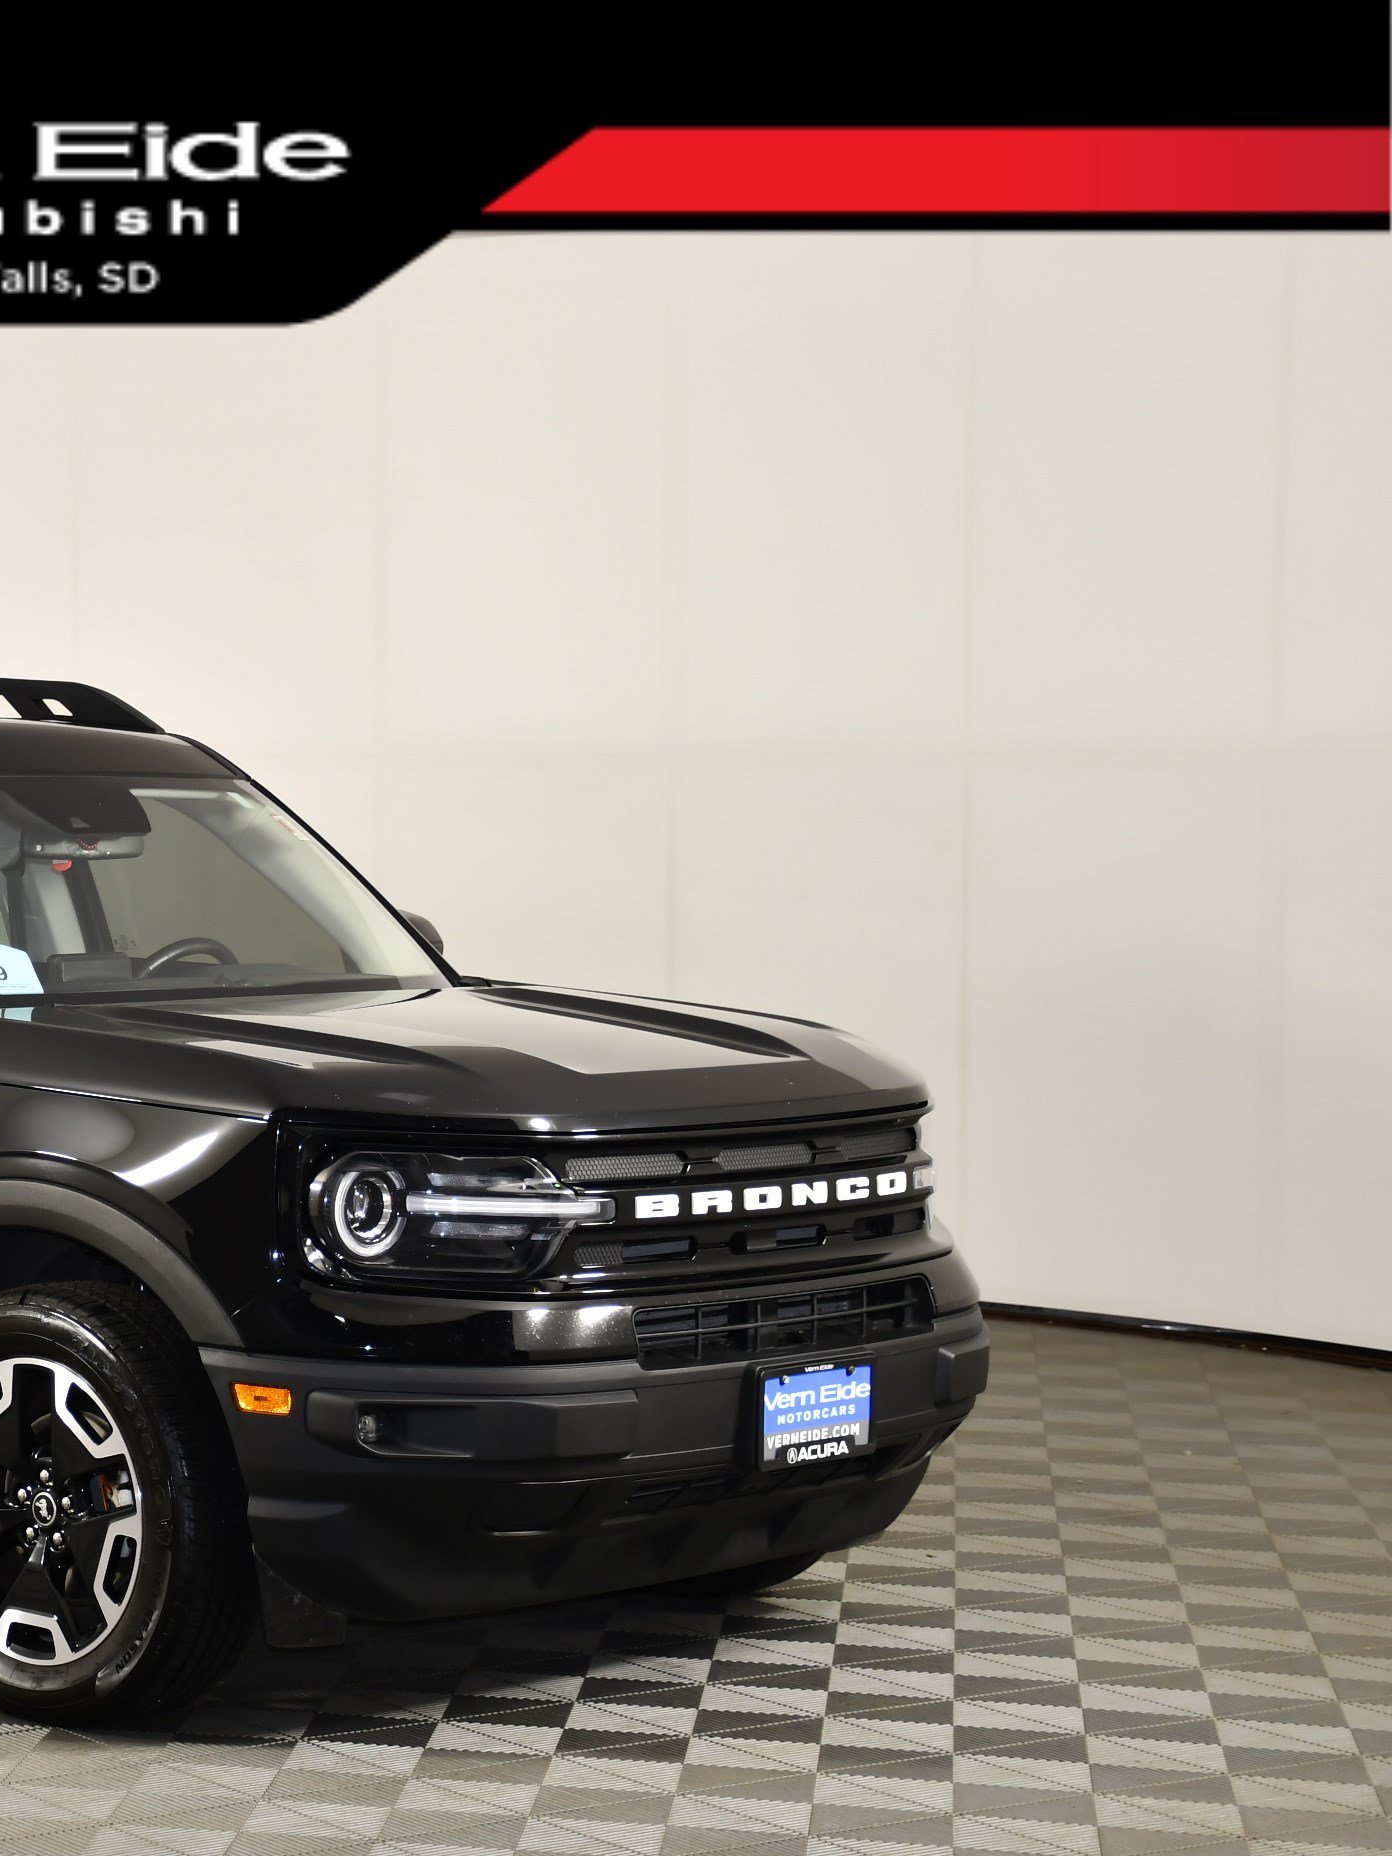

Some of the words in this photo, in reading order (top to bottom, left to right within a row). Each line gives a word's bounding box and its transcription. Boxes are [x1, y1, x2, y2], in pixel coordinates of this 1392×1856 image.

[635, 1171, 907, 1219] BRONCO
[764, 1389, 815, 1411] Vern
[820, 1381, 871, 1403] Eide
[777, 1404, 856, 1425] MOTORCARS
[767, 1423, 860, 1449] VERNEIDE.COM
[798, 1440, 849, 1461] ACURA
